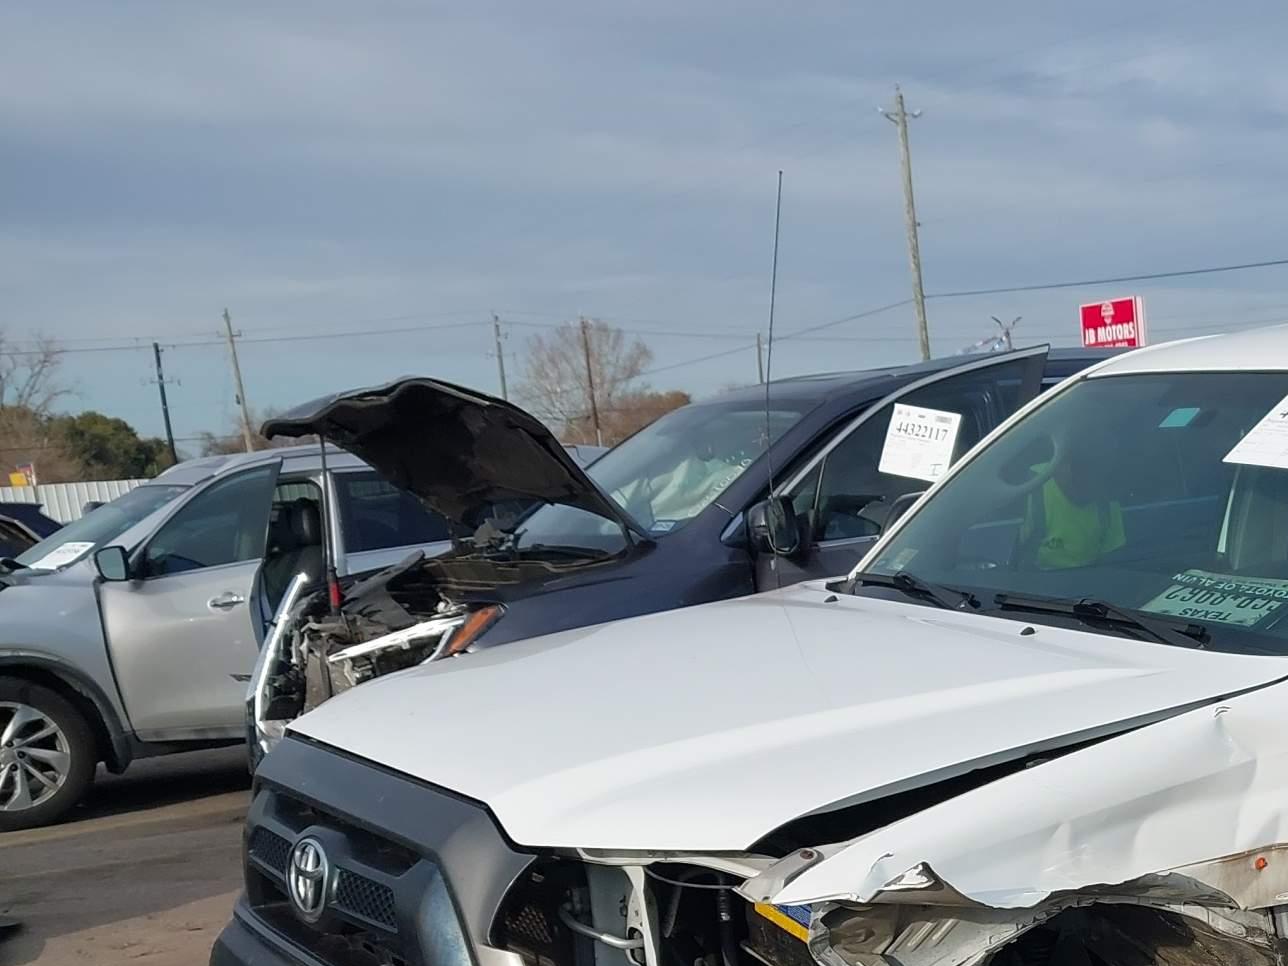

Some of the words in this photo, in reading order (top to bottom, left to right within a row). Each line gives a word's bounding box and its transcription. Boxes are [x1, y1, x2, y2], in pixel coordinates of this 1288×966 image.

[1097, 321, 1135, 342] MOTORS
[896, 421, 949, 441] 44322117
[1172, 573, 1212, 586] ALVIN
[1214, 581, 1236, 590] OF
[1179, 607, 1233, 621] TEXAS
